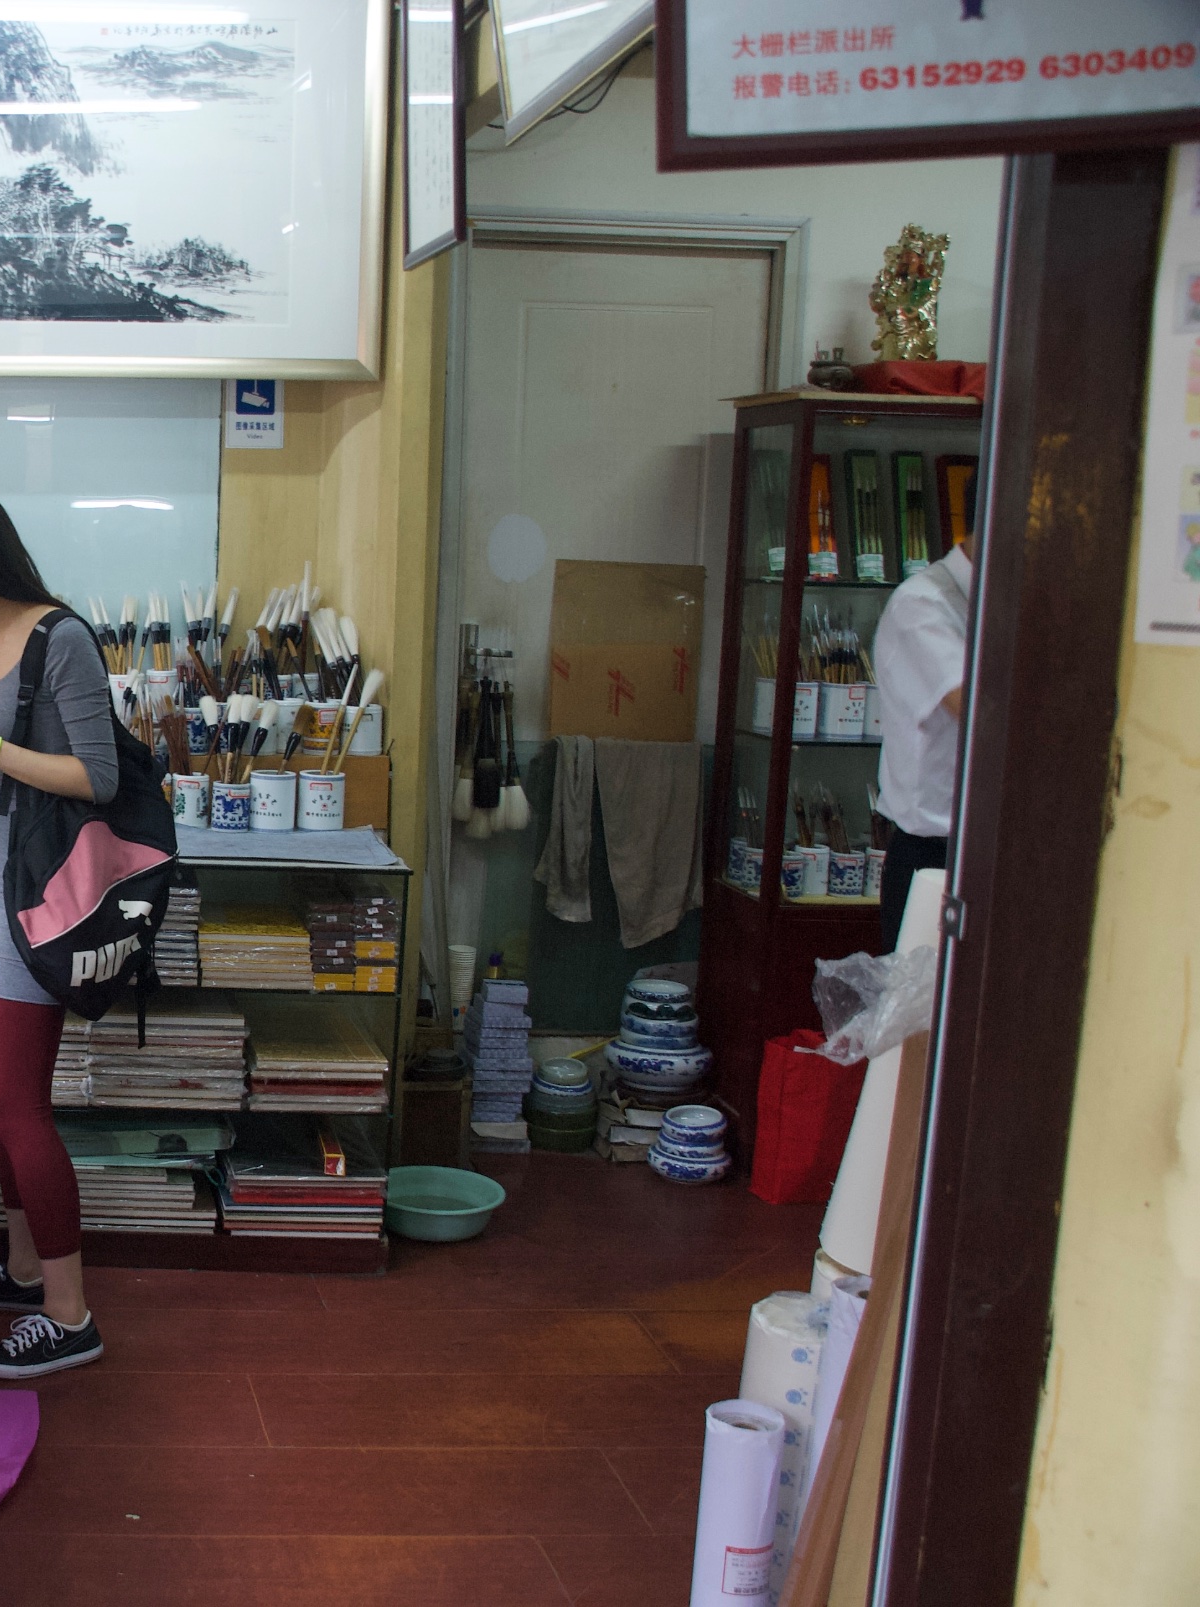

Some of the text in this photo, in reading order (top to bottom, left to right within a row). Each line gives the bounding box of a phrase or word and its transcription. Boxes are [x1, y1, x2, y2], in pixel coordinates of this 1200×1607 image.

[732, 25, 896, 59] 大栅栏派出所
[859, 57, 1027, 92] 63152929
[1038, 41, 1197, 80] 6303409
[69, 931, 142, 988] PUM
